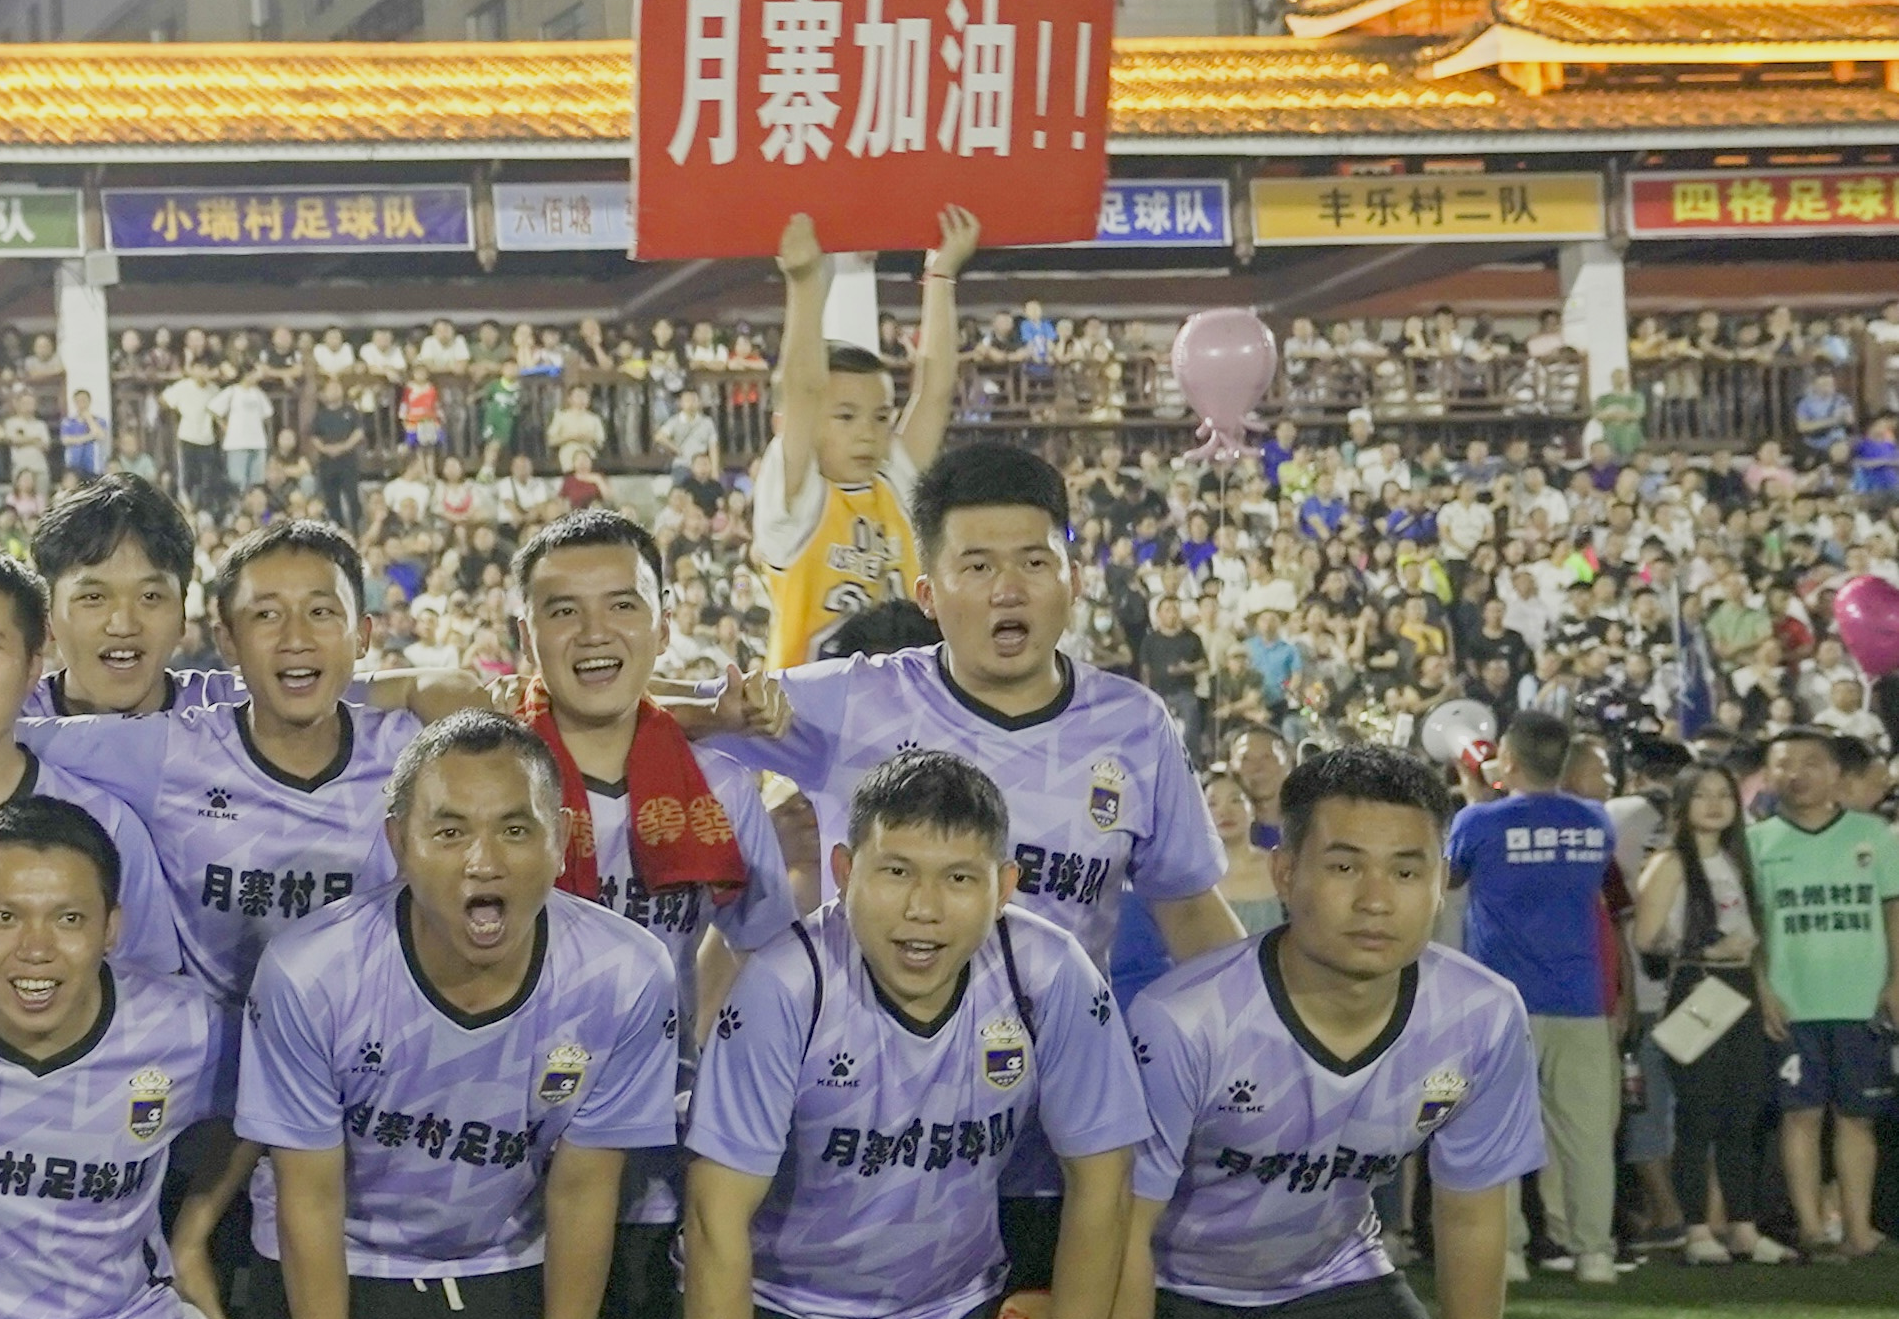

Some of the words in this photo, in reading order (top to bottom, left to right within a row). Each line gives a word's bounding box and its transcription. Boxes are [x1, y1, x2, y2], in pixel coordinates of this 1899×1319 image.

[152, 196, 425, 242] 小瑞村足球队
[1096, 188, 1213, 236] 足球队
[1318, 185, 1538, 228] 丰乐村二队
[1673, 178, 1899, 224] 四格足球
[197, 809, 239, 820] KELME
[1015, 844, 1110, 905] 足球队
[816, 1078, 861, 1087] KELME
[1218, 1104, 1266, 1113] KELME
